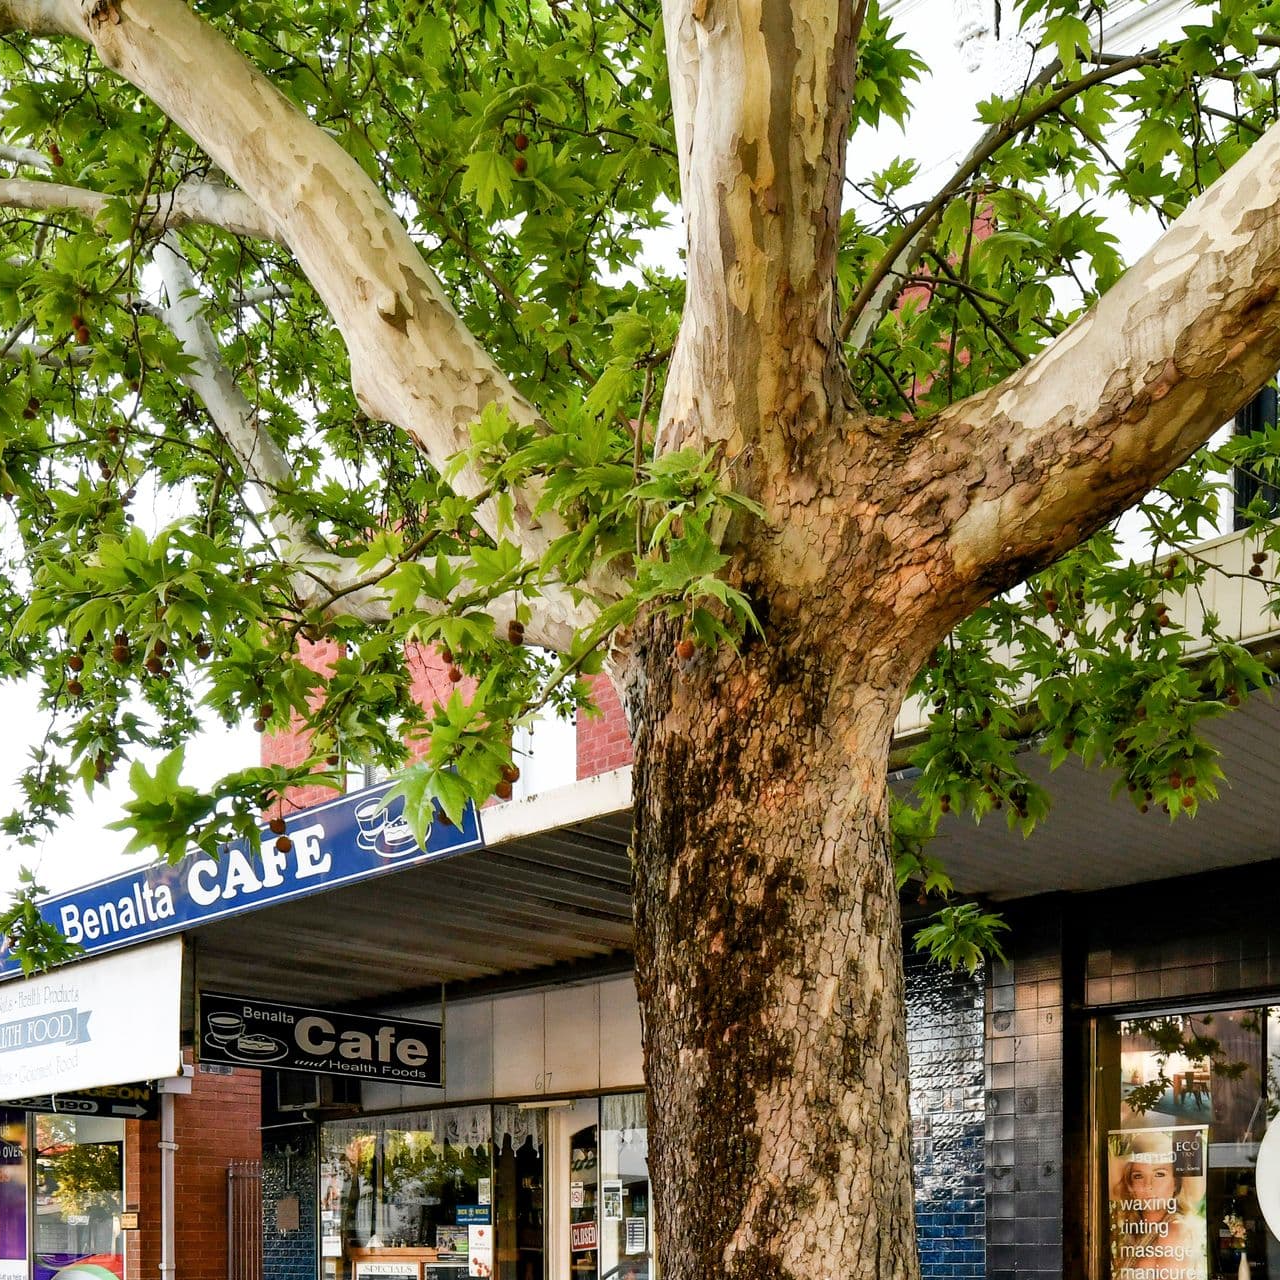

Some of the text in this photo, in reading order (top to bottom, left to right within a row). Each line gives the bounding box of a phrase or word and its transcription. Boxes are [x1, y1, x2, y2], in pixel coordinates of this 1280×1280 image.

[187, 824, 333, 906] CAFE
[19, 986, 41, 1008] Health
[43, 984, 80, 1005] Products
[27, 1014, 73, 1044] FOOD
[294, 1016, 429, 1067] Cafe
[294, 1059, 426, 1078] and Health Foods
[535, 1072, 553, 1090] 67
[77, 1084, 150, 1101] GEON
[3, 1145, 23, 1159] OVER
[1176, 1141, 1200, 1152] ECO
[1120, 1198, 1177, 1214] waxing
[573, 1227, 596, 1247] CLOSED
[363, 1264, 413, 1274] SPECIALS
